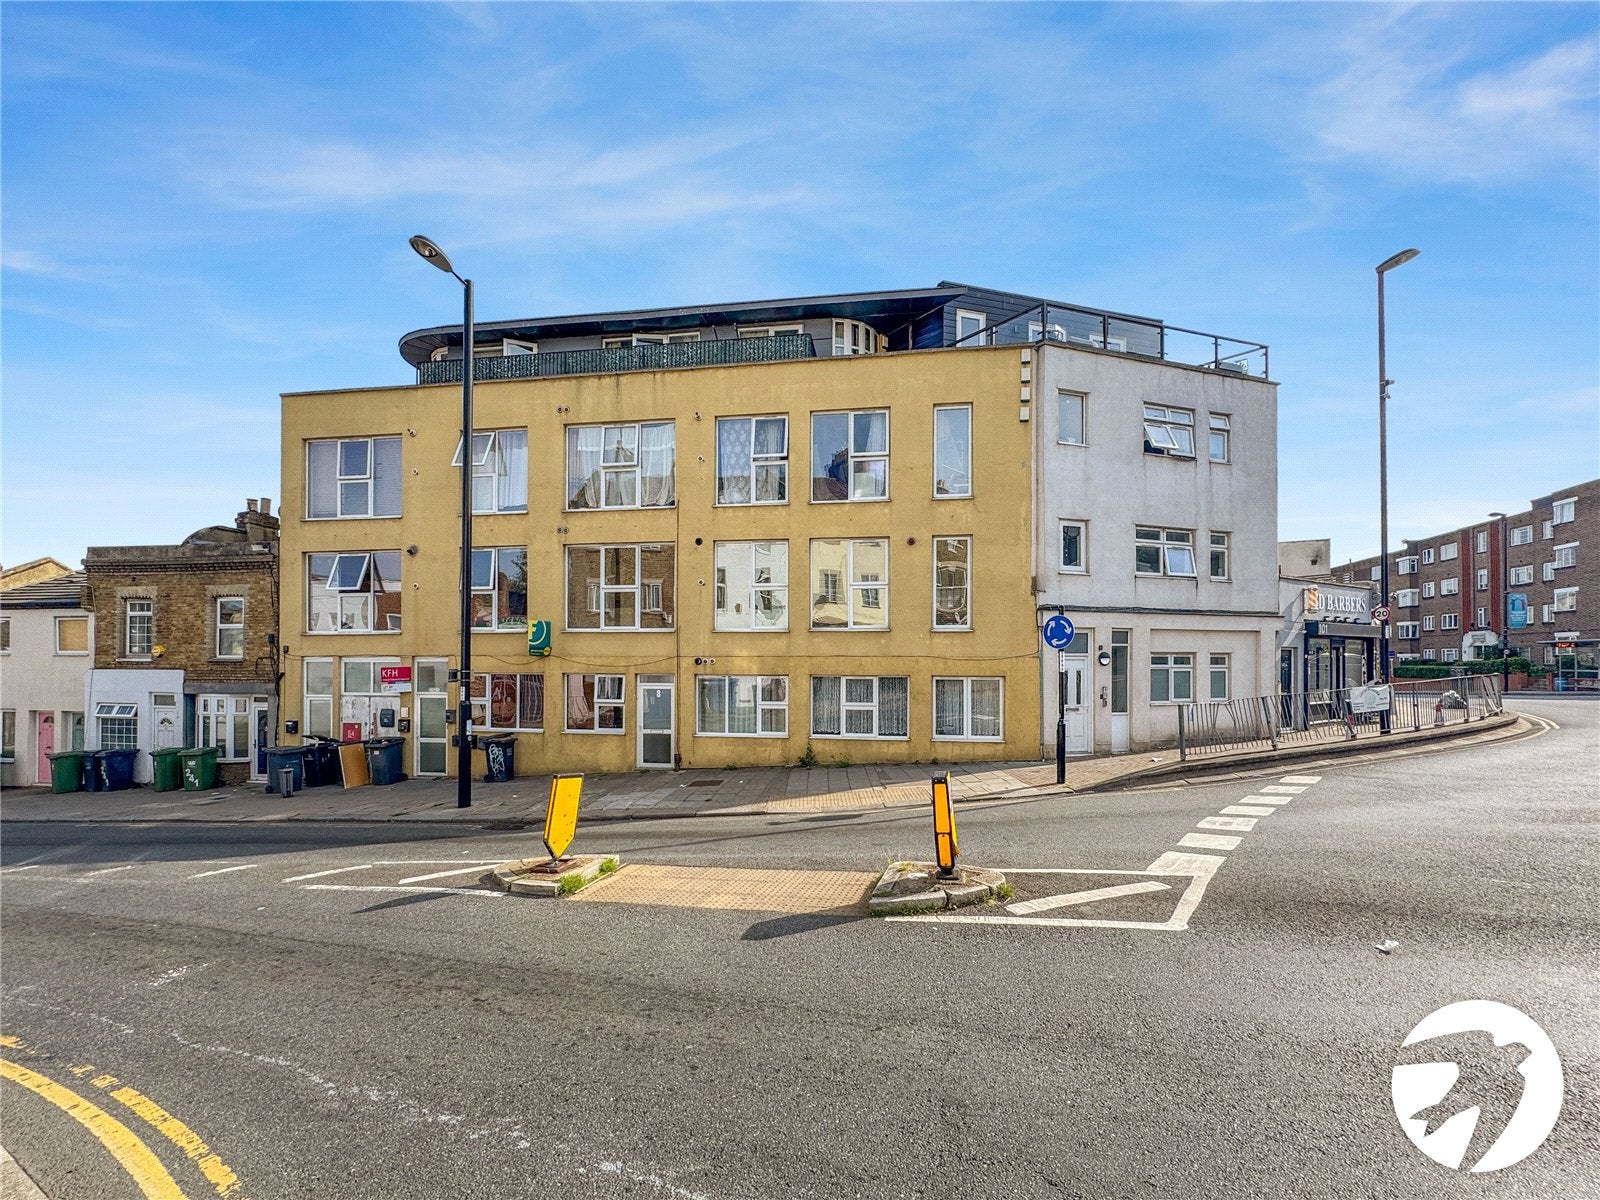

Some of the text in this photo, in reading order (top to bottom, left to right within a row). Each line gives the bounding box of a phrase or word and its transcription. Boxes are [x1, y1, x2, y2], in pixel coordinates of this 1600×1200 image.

[1318, 623, 1328, 634] 101
[381, 669, 399, 678] KFH
[656, 689, 662, 698] 8
[185, 768, 199, 788] 241
